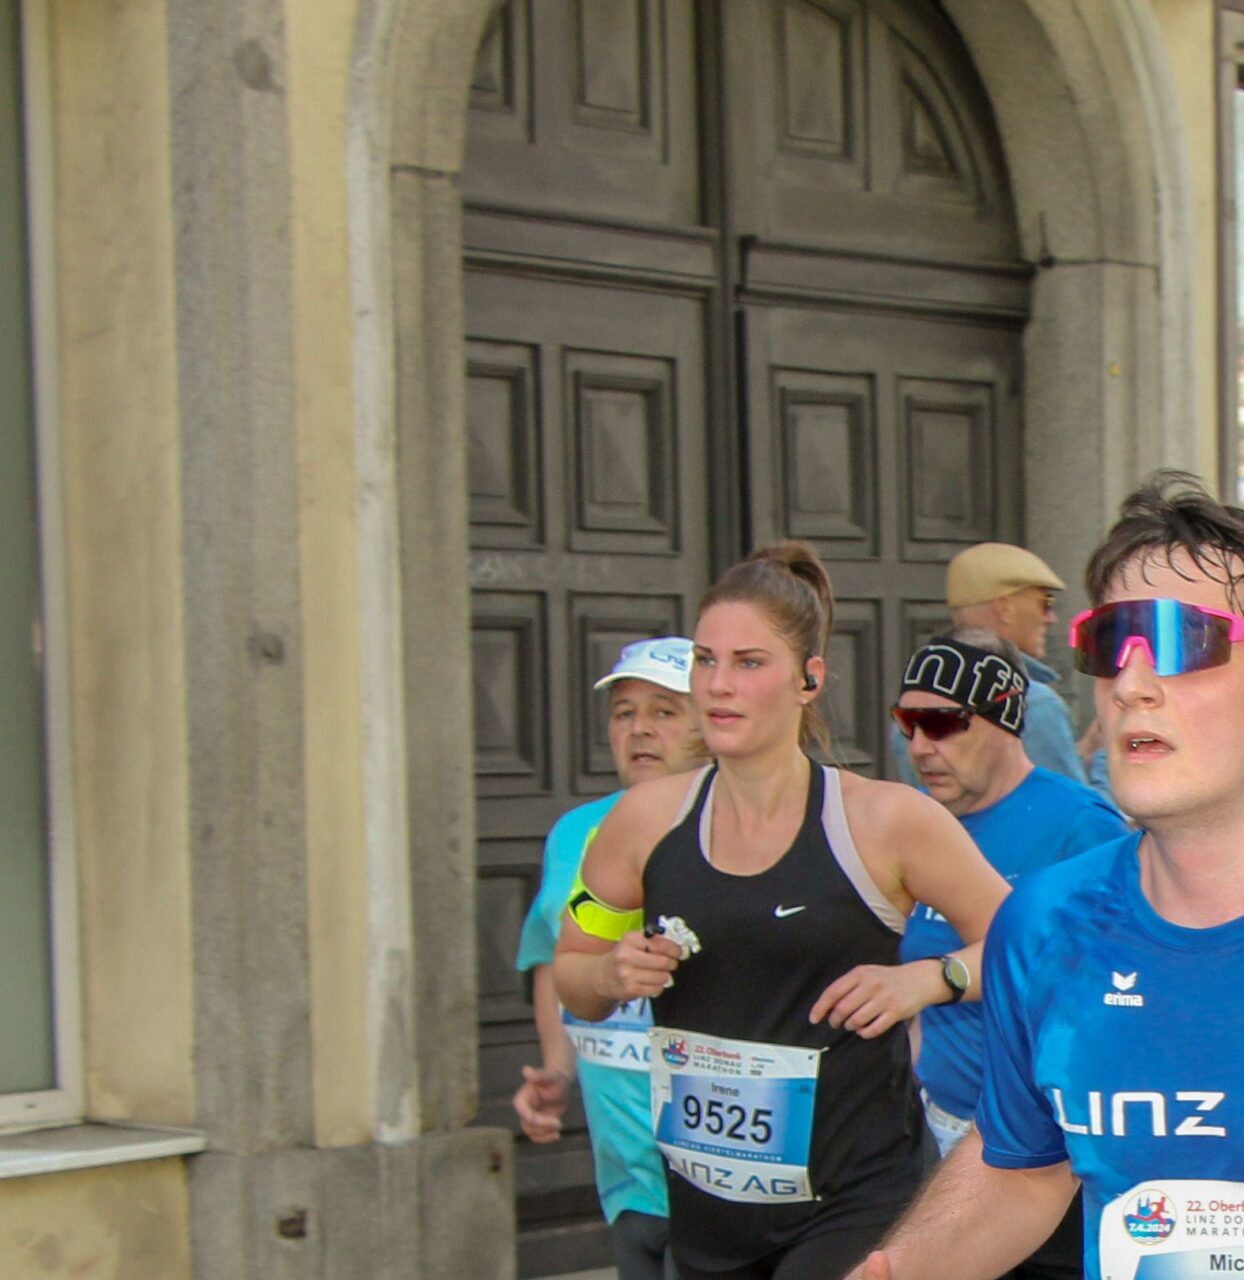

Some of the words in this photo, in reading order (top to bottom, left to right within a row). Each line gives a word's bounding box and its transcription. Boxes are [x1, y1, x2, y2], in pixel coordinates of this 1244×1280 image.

[1103, 992, 1144, 1006] erima
[711, 1082, 740, 1098] Irene
[683, 1095, 773, 1144] 9525
[1052, 1088, 1226, 1137] LINZ
[742, 1174, 797, 1196] AG
[1186, 1200, 1205, 1213] 22.
[1186, 1214, 1217, 1226] LINZ
